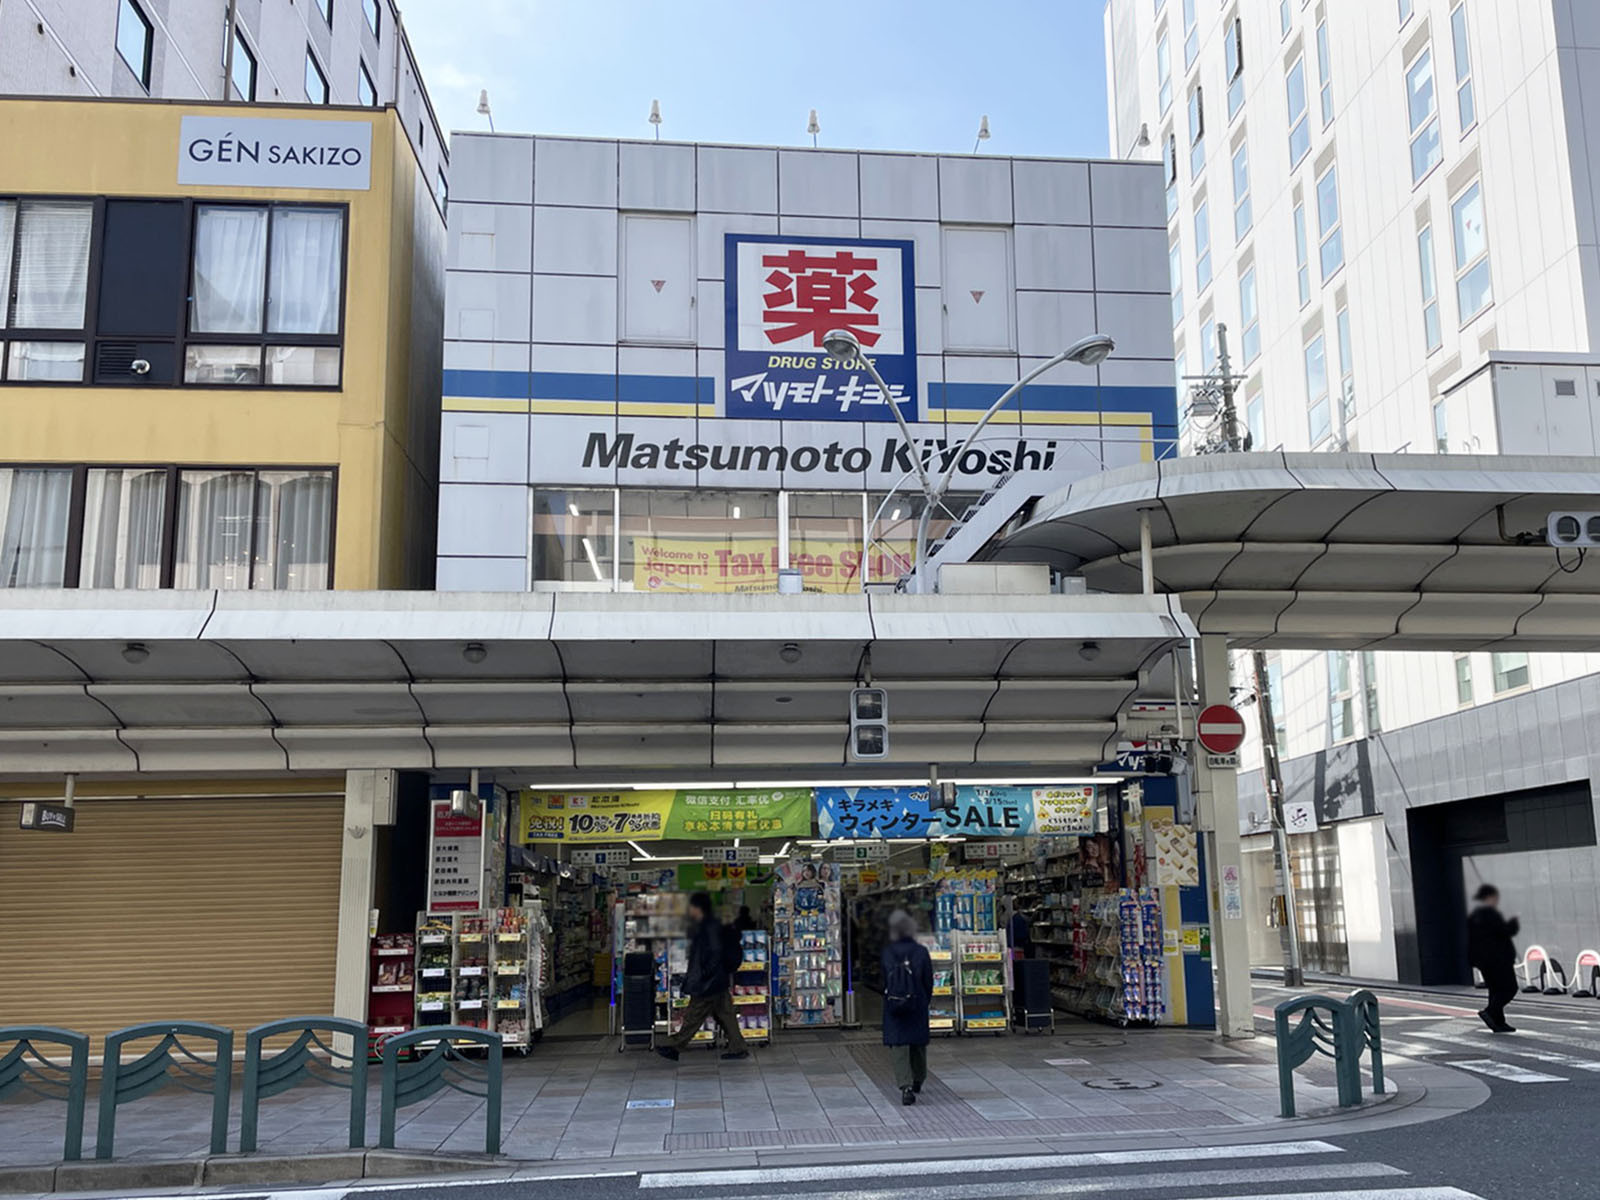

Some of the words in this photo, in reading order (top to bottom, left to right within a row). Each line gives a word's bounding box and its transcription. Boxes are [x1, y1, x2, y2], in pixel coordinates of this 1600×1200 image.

[188, 132, 260, 163] GÉN
[268, 145, 362, 166] SAKIZO
[762, 249, 881, 348] 薬
[768, 356, 816, 369] DRUG
[582, 433, 872, 473] Matsumoto
[881, 438, 1057, 475] KiYoshi
[642, 545, 696, 561] Welcome
[700, 551, 709, 561] to
[714, 549, 766, 578] Tax
[642, 558, 709, 577] Japan!
[838, 799, 894, 812] キラメキ
